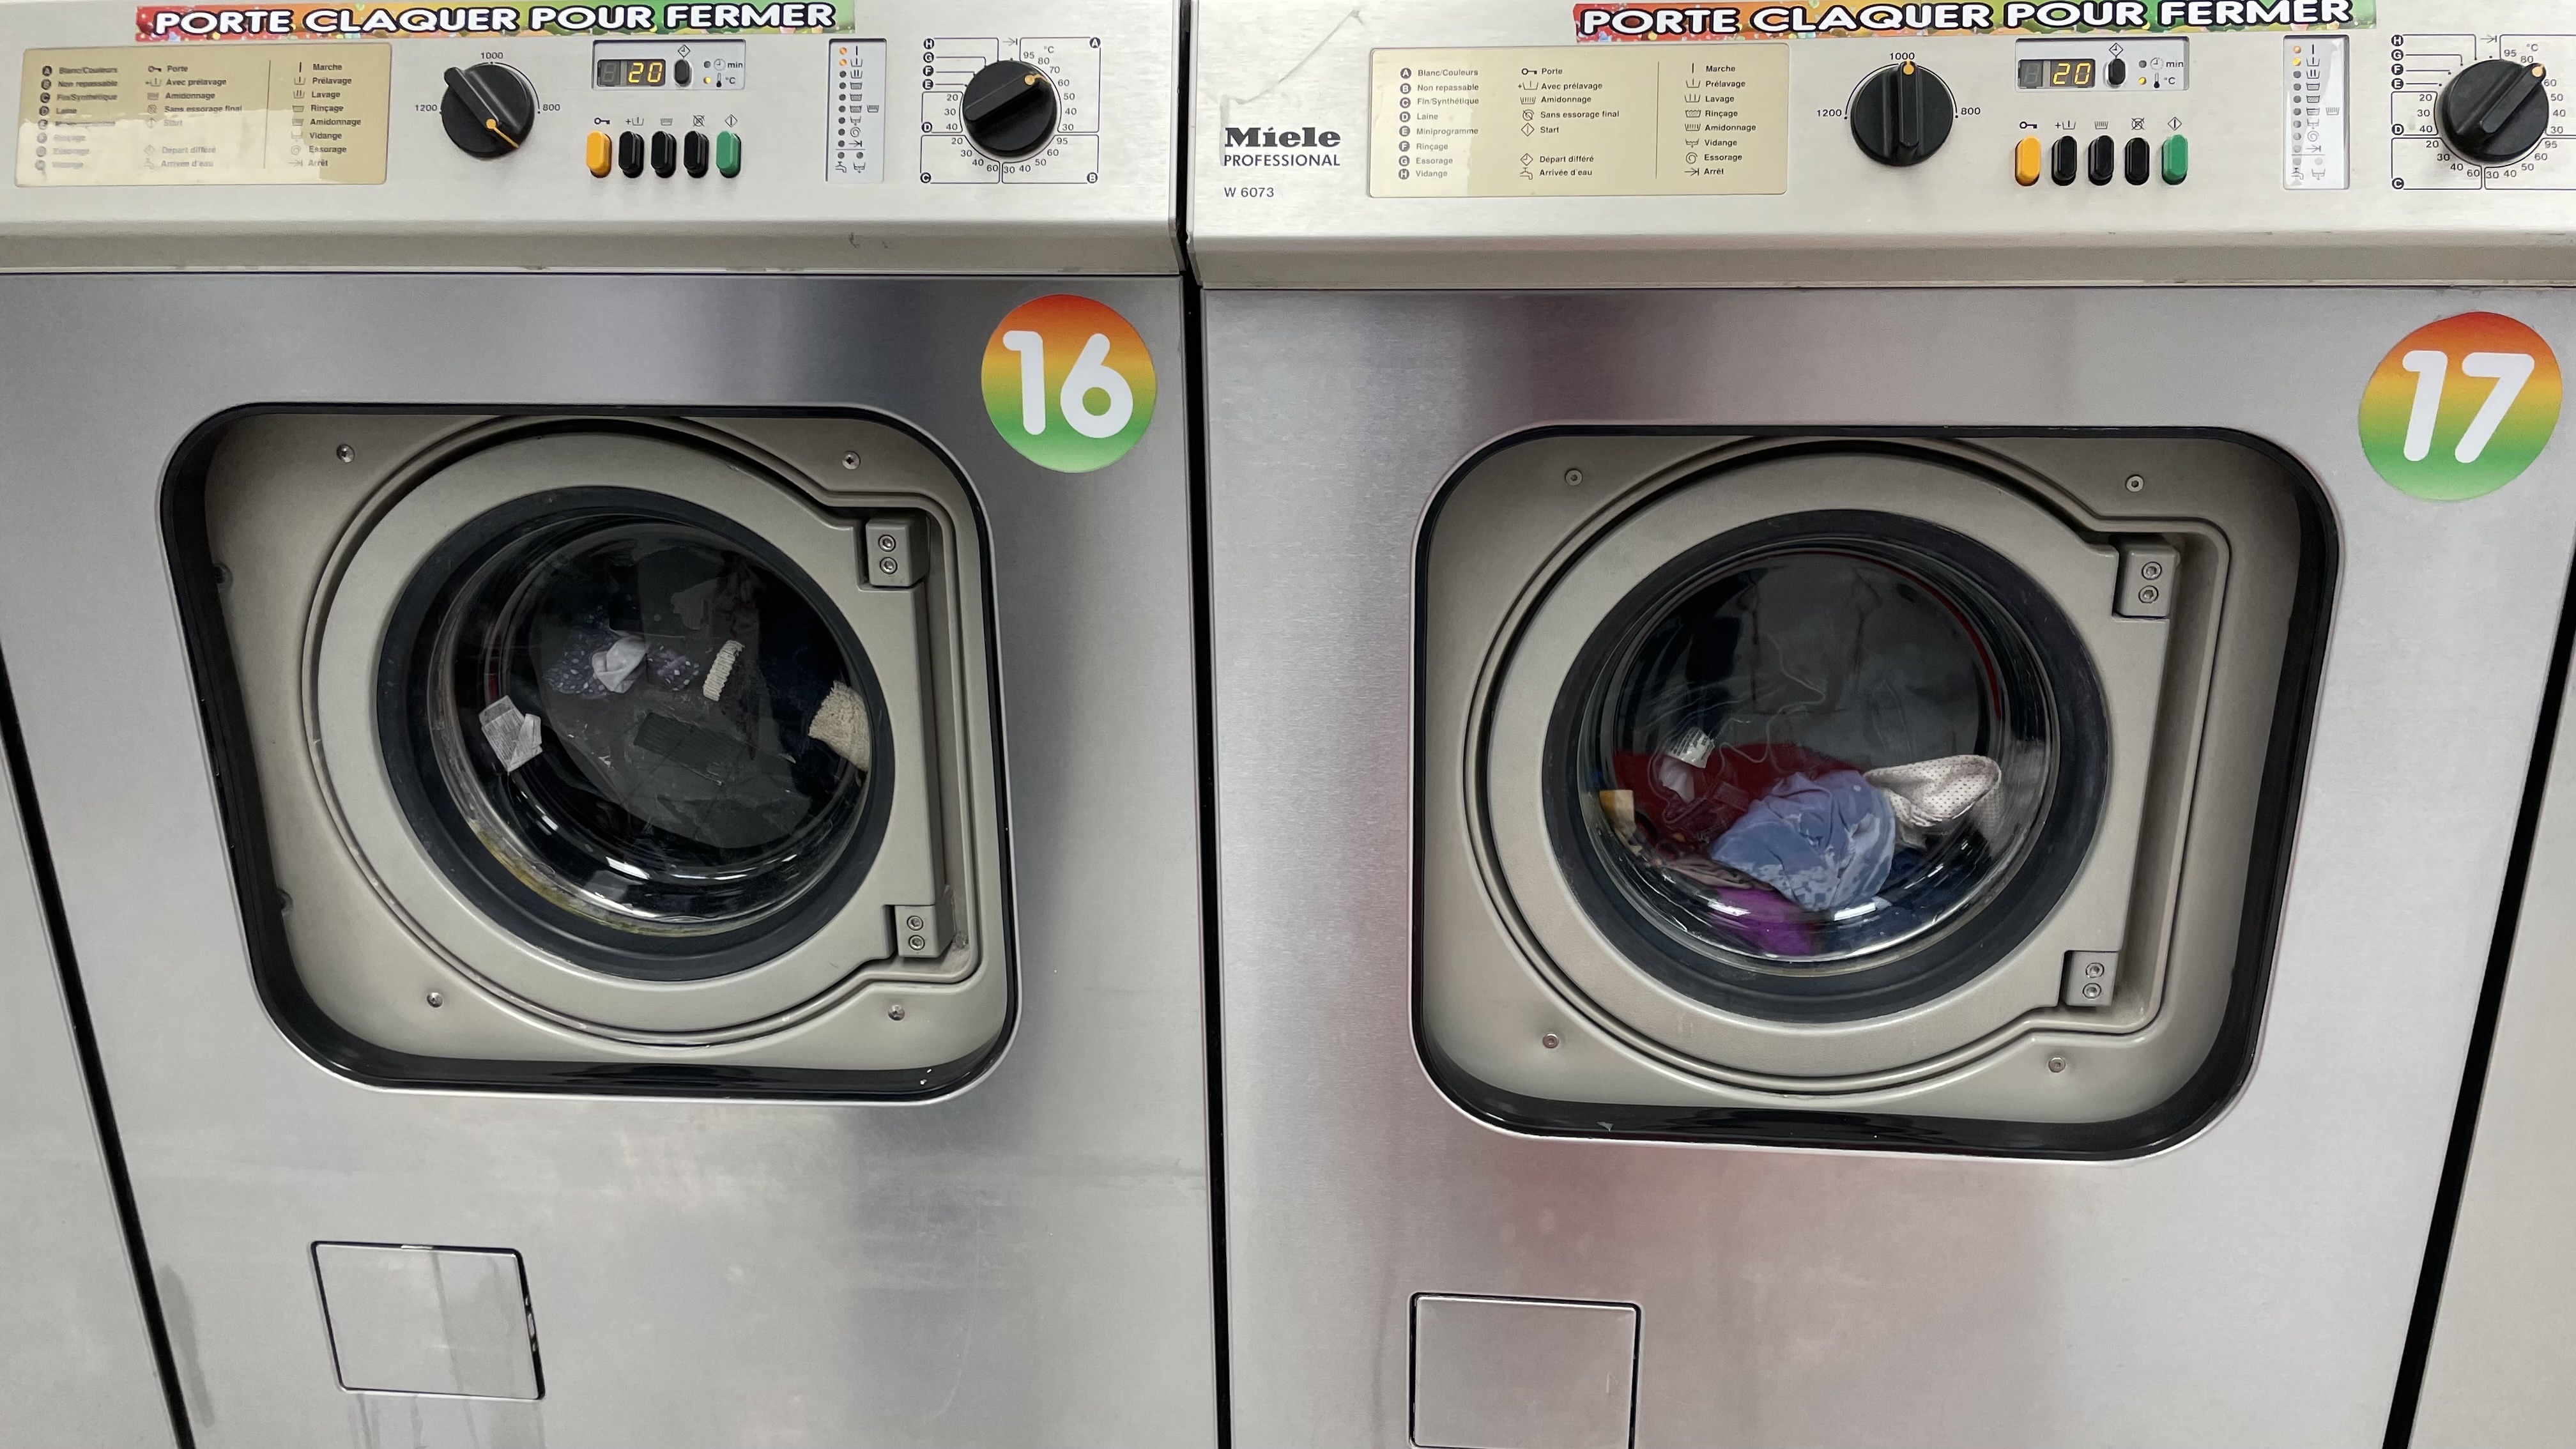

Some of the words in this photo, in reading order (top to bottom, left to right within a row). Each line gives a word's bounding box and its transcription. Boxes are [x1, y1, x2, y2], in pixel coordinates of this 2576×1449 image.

[155, 9, 293, 34] PORTE
[304, 7, 518, 33] CLAQUER
[530, 4, 653, 31] POUR
[666, 3, 834, 29] FERMER
[1583, 8, 1740, 34] PORTE
[1752, 4, 1991, 32] CLAQUER
[2005, 1, 2144, 27] POUR
[2159, 0, 2352, 26] FERMER
[1043, 45, 1055, 54] °C
[2526, 43, 2538, 52] °C
[1890, 52, 1915, 61] 1000
[628, 62, 663, 83] 20
[2053, 63, 2091, 84] 20
[312, 77, 352, 86] Prélavage
[1705, 80, 1746, 88] Prélavage
[1436, 84, 1479, 92] repassable
[1563, 82, 1602, 91] prélavage
[311, 91, 341, 99] Lavage
[1705, 95, 1735, 103] Lavage
[1417, 98, 1479, 106] Fin/Synthétique
[1541, 96, 1591, 104] Amidonnage
[310, 104, 344, 112] Rinçage
[1705, 110, 1738, 118] Rinçage
[310, 118, 362, 126] Amidonnage
[1416, 128, 1478, 136] Miniprogramme
[1705, 124, 1756, 132] Amidonnage
[309, 132, 342, 140] Vidange
[1225, 126, 1341, 148] Miele
[1416, 143, 1448, 151] Rinçage
[1705, 139, 1737, 148] Vidange
[309, 146, 347, 154] Essorage
[1224, 154, 1340, 166] PROFESSIONAL
[1416, 157, 1453, 165] Essorage
[1540, 155, 1566, 164] Départ
[1704, 154, 1742, 162] Essorage
[1416, 170, 1448, 178] Vidange
[1224, 187, 1236, 197] W
[1241, 187, 1274, 197] 6073
[1003, 330, 1133, 438] 16
[2402, 350, 2534, 463] 17
